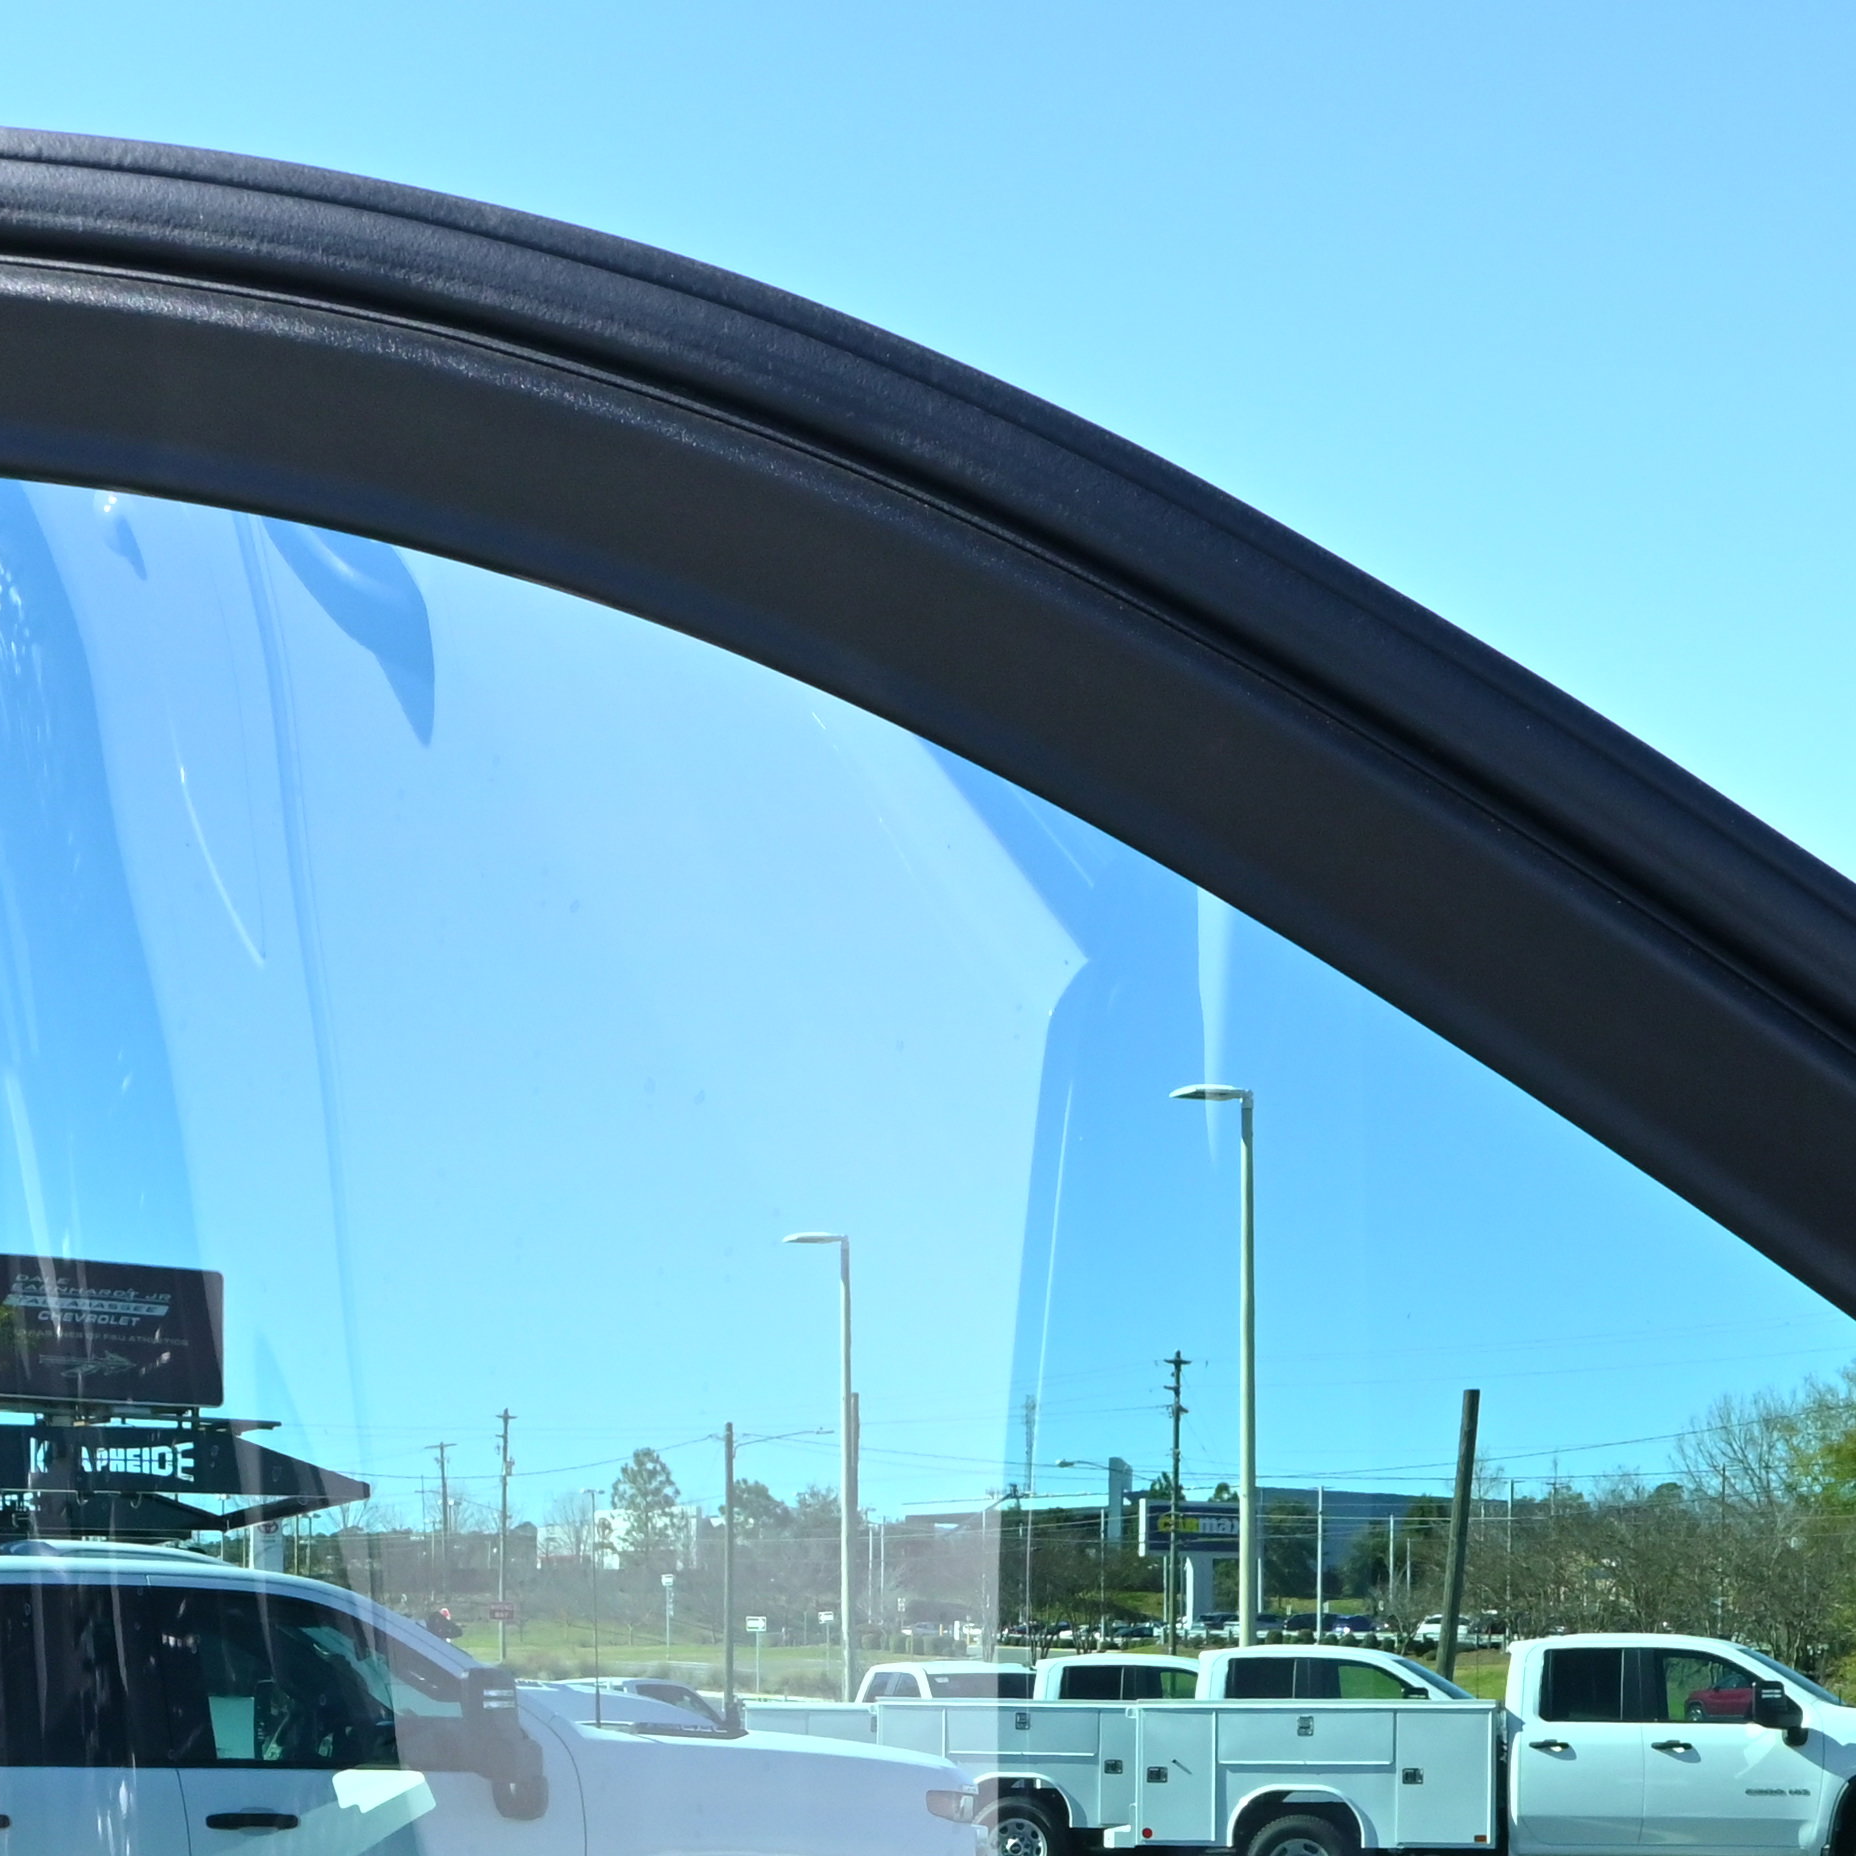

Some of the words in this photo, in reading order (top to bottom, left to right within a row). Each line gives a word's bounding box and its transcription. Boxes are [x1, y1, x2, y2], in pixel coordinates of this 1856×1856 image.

[145, 1293, 172, 1303] JR
[38, 1310, 141, 1327] CHEVROLET
[29, 1436, 195, 1483] KAPHEIDE
